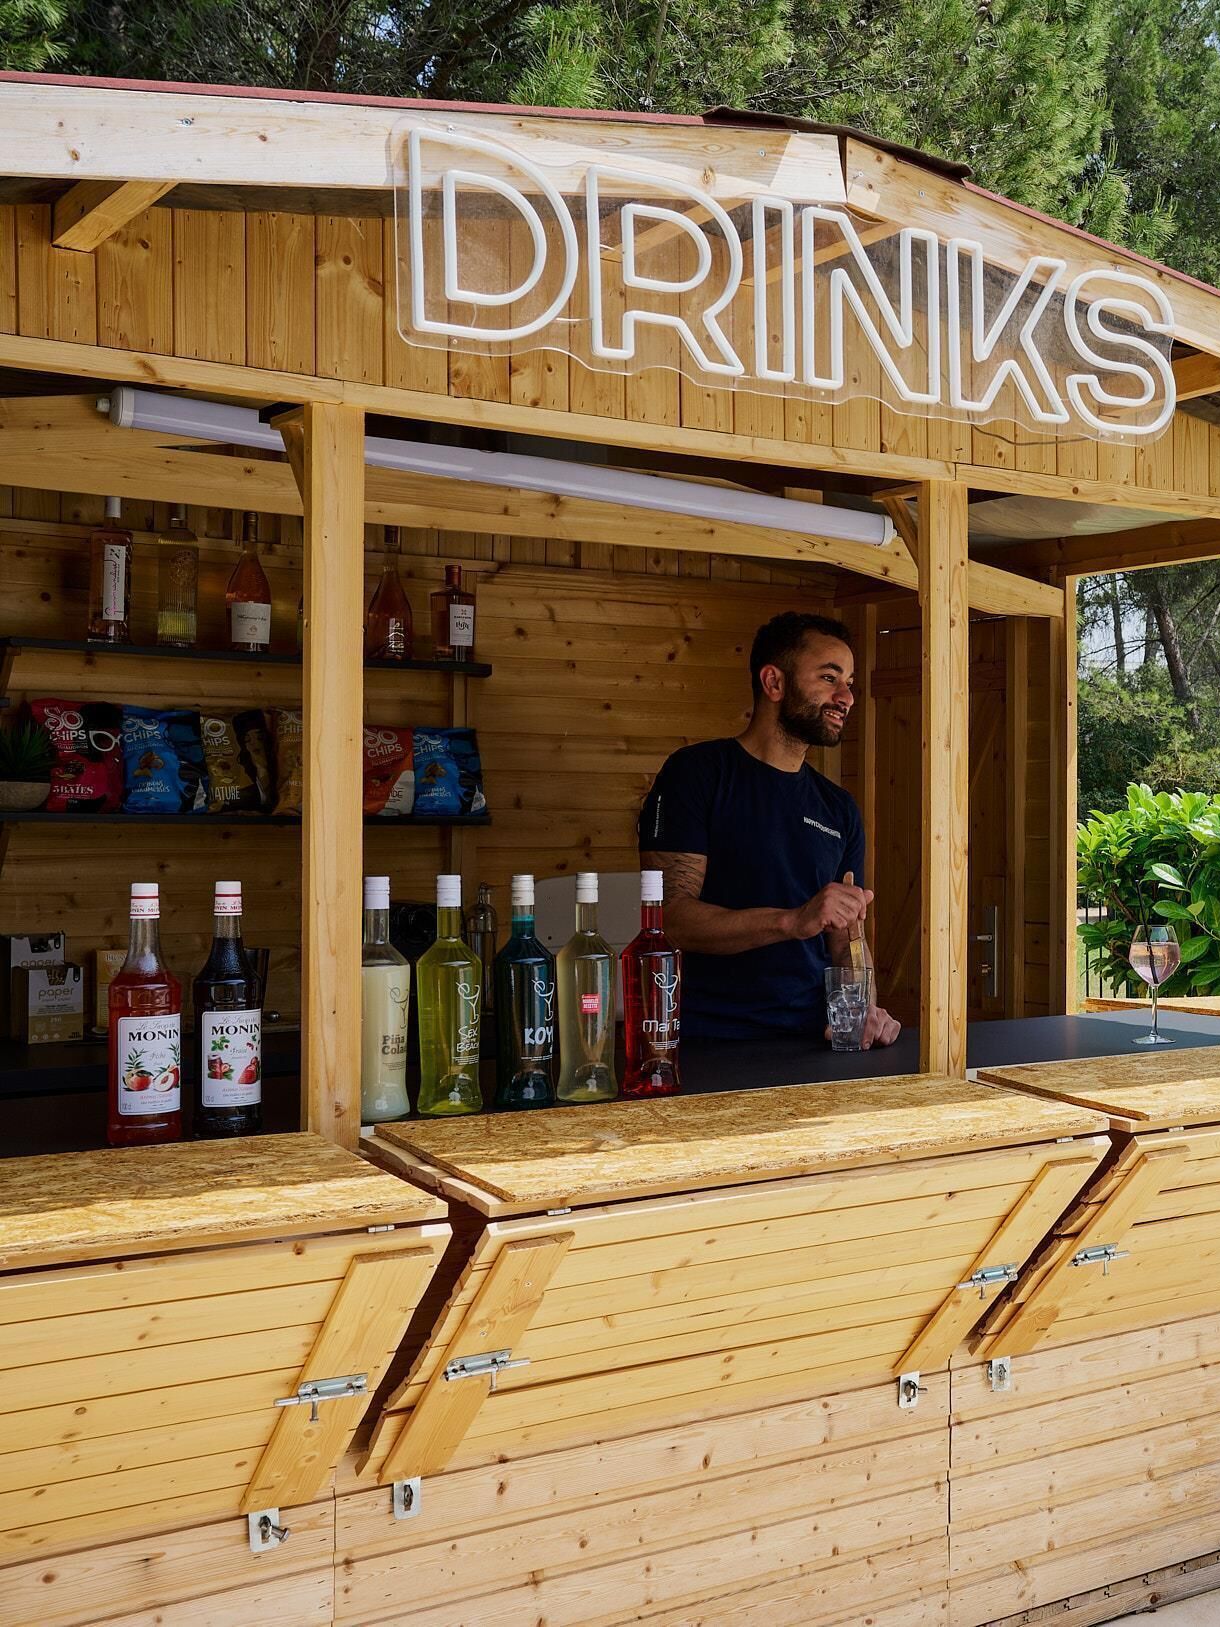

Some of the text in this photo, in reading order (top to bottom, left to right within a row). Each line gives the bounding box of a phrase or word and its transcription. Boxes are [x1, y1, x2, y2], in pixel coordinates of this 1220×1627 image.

[408, 127, 1177, 436] DRINKS
[208, 785, 240, 801] NATURE
[38, 986, 75, 1001] paper
[128, 1028, 179, 1042] MONIN
[211, 1023, 260, 1036] MONIN
[524, 1025, 554, 1045] KOY
[382, 1034, 405, 1045] Piña
